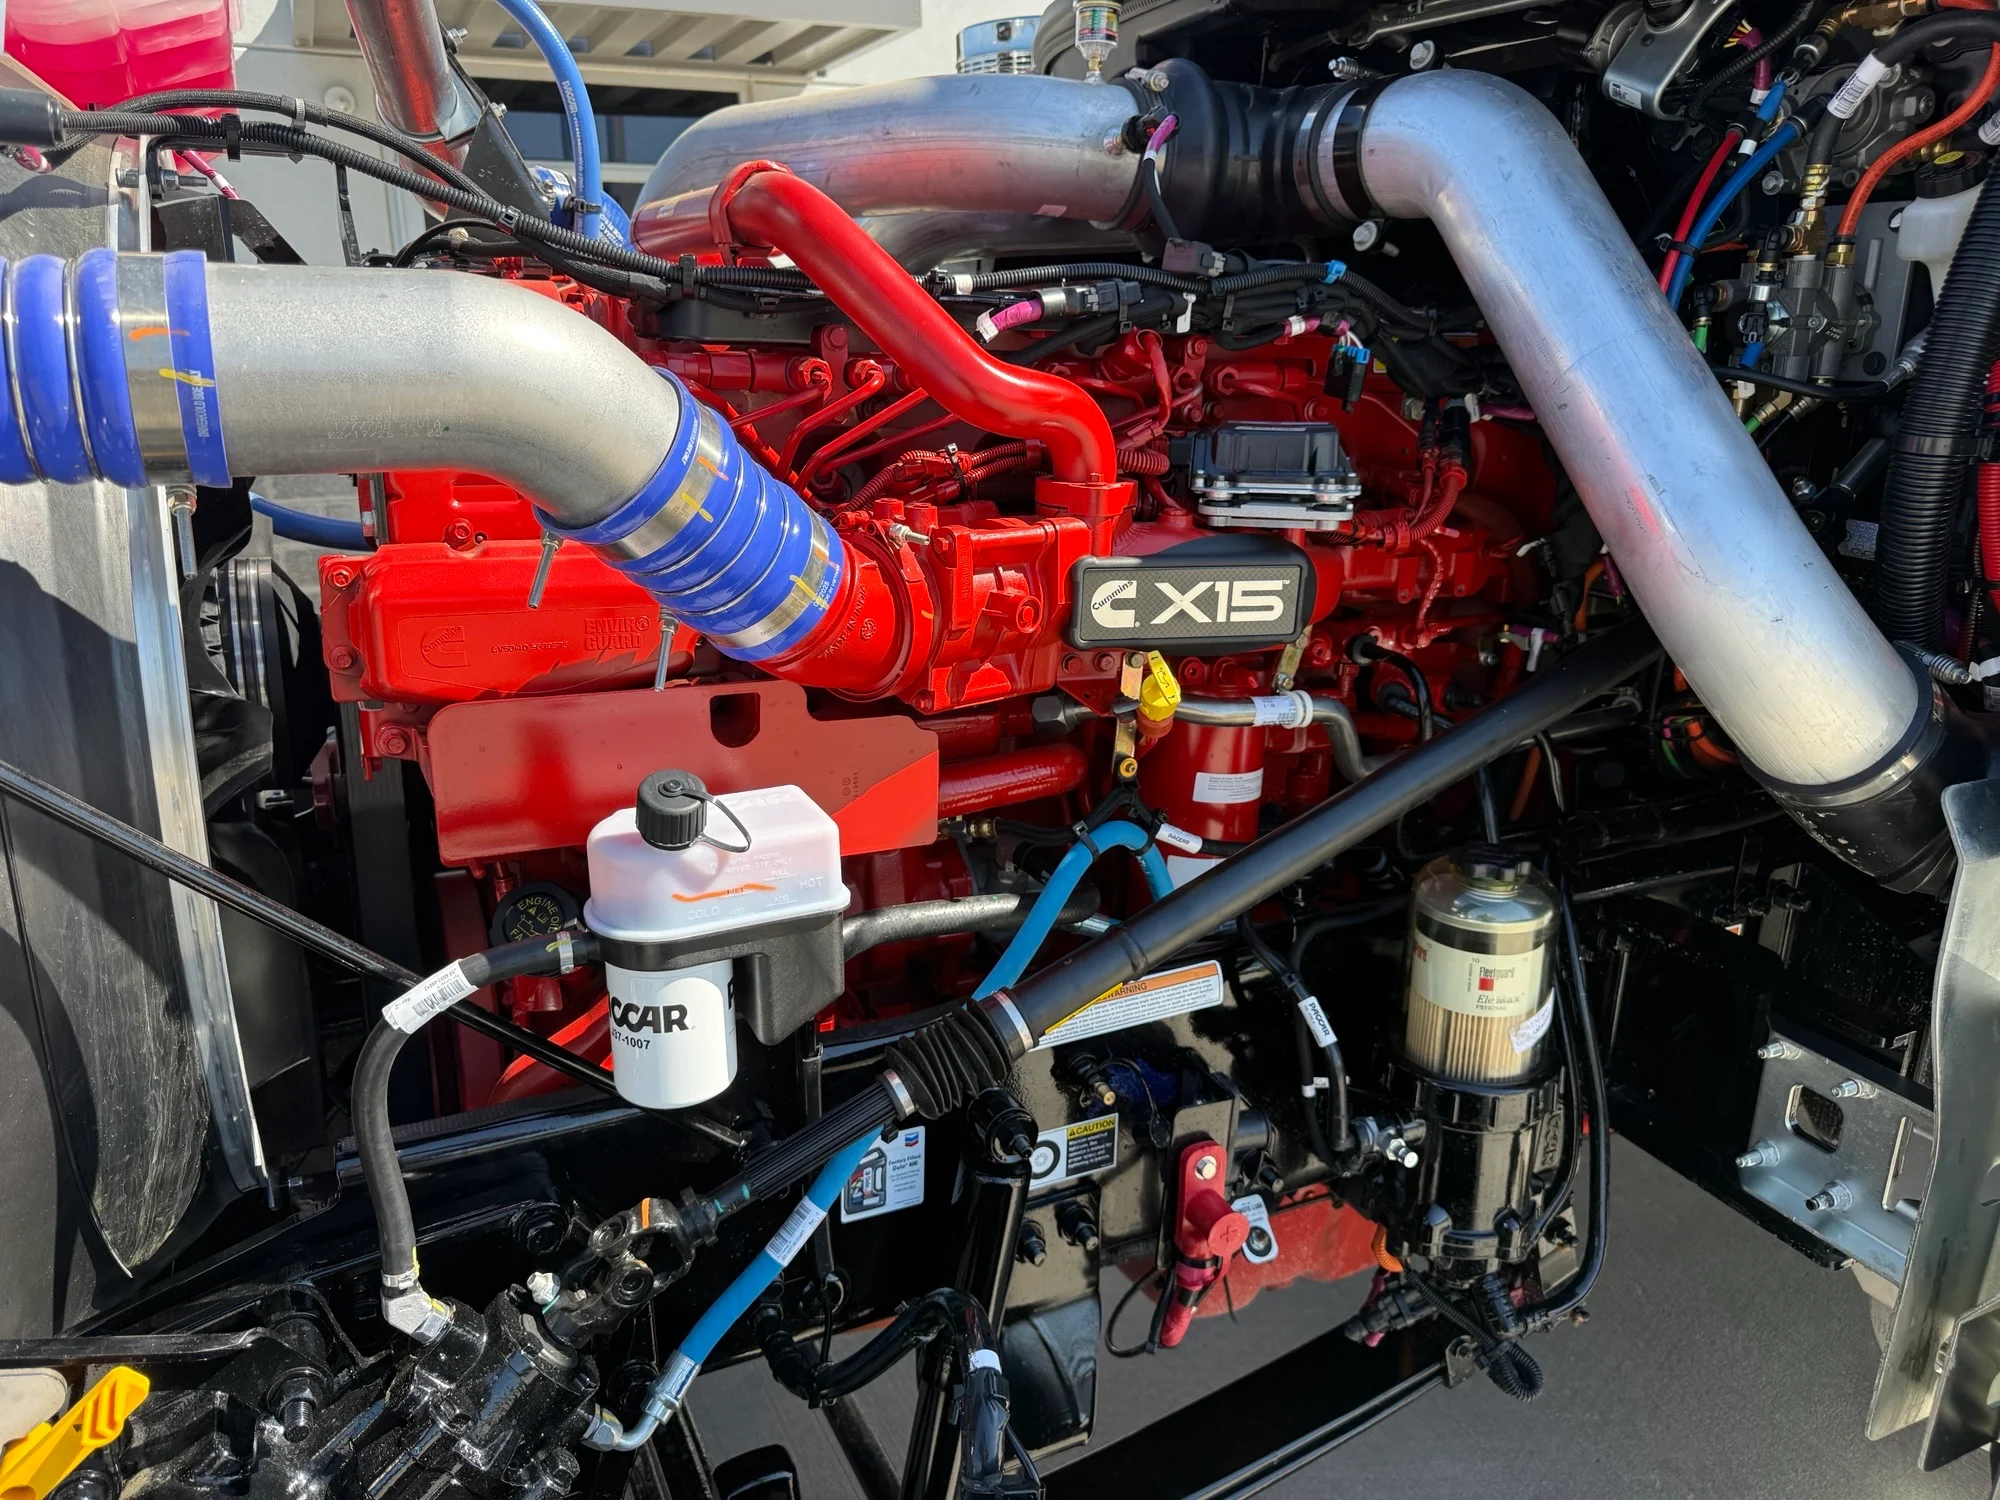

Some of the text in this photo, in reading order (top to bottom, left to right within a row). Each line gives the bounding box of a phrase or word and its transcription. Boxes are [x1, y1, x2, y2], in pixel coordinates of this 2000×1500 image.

[561, 79, 578, 114] PACCAR
[813, 581, 830, 607] 0/2025
[1092, 579, 1134, 611] Cummins
[1150, 580, 1284, 624] X15
[421, 625, 462, 654] Cummins
[584, 633, 644, 651] GUARD
[798, 876, 824, 890] HOT
[517, 896, 559, 915] ENGINE
[686, 905, 720, 921] COLD
[1479, 966, 1516, 980] Fleetguard
[608, 996, 690, 1034] CCAR
[1308, 1002, 1330, 1037] PACCAR
[1076, 1119, 1114, 1135] CAUTION
